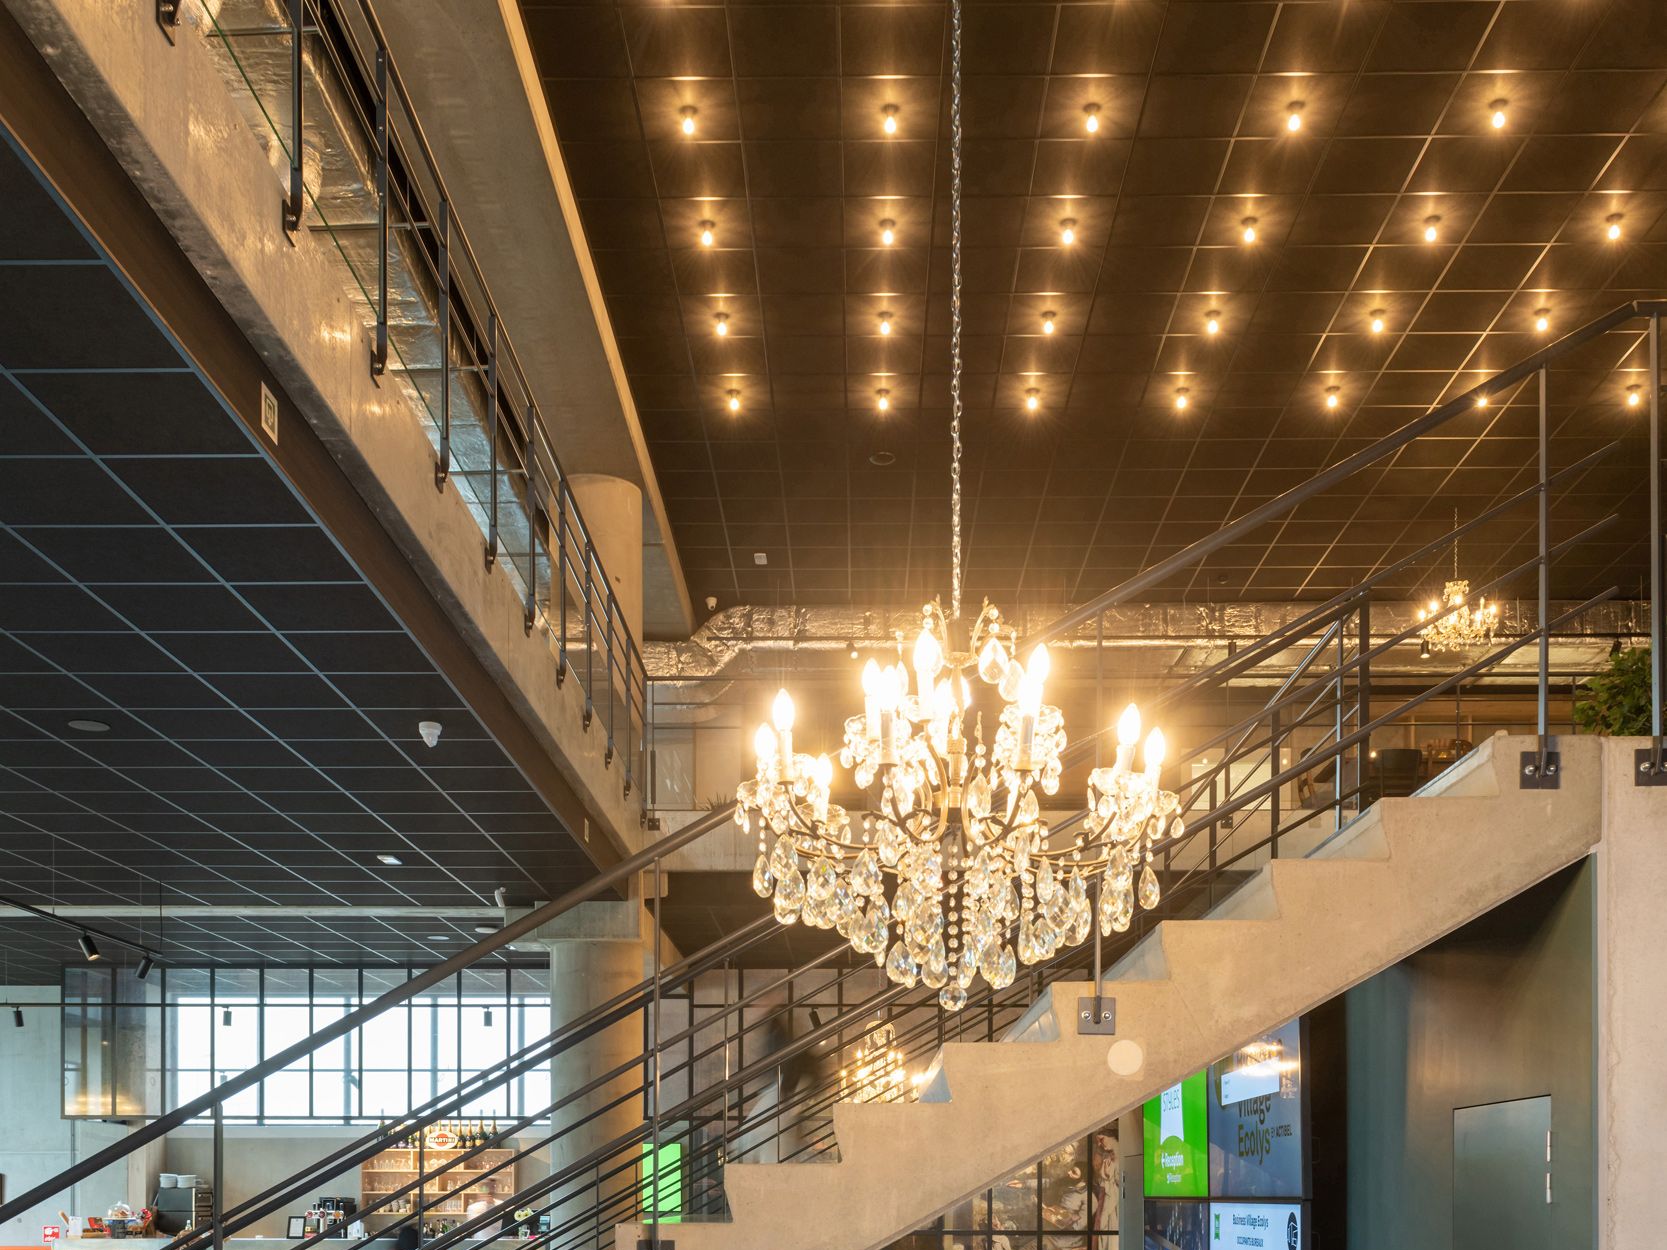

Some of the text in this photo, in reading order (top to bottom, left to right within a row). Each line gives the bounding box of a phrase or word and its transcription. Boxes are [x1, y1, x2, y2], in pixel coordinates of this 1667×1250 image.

[1238, 1121, 1271, 1165] Ecolys
[1232, 1213, 1246, 1226] Business
[1246, 1214, 1257, 1230] Village
